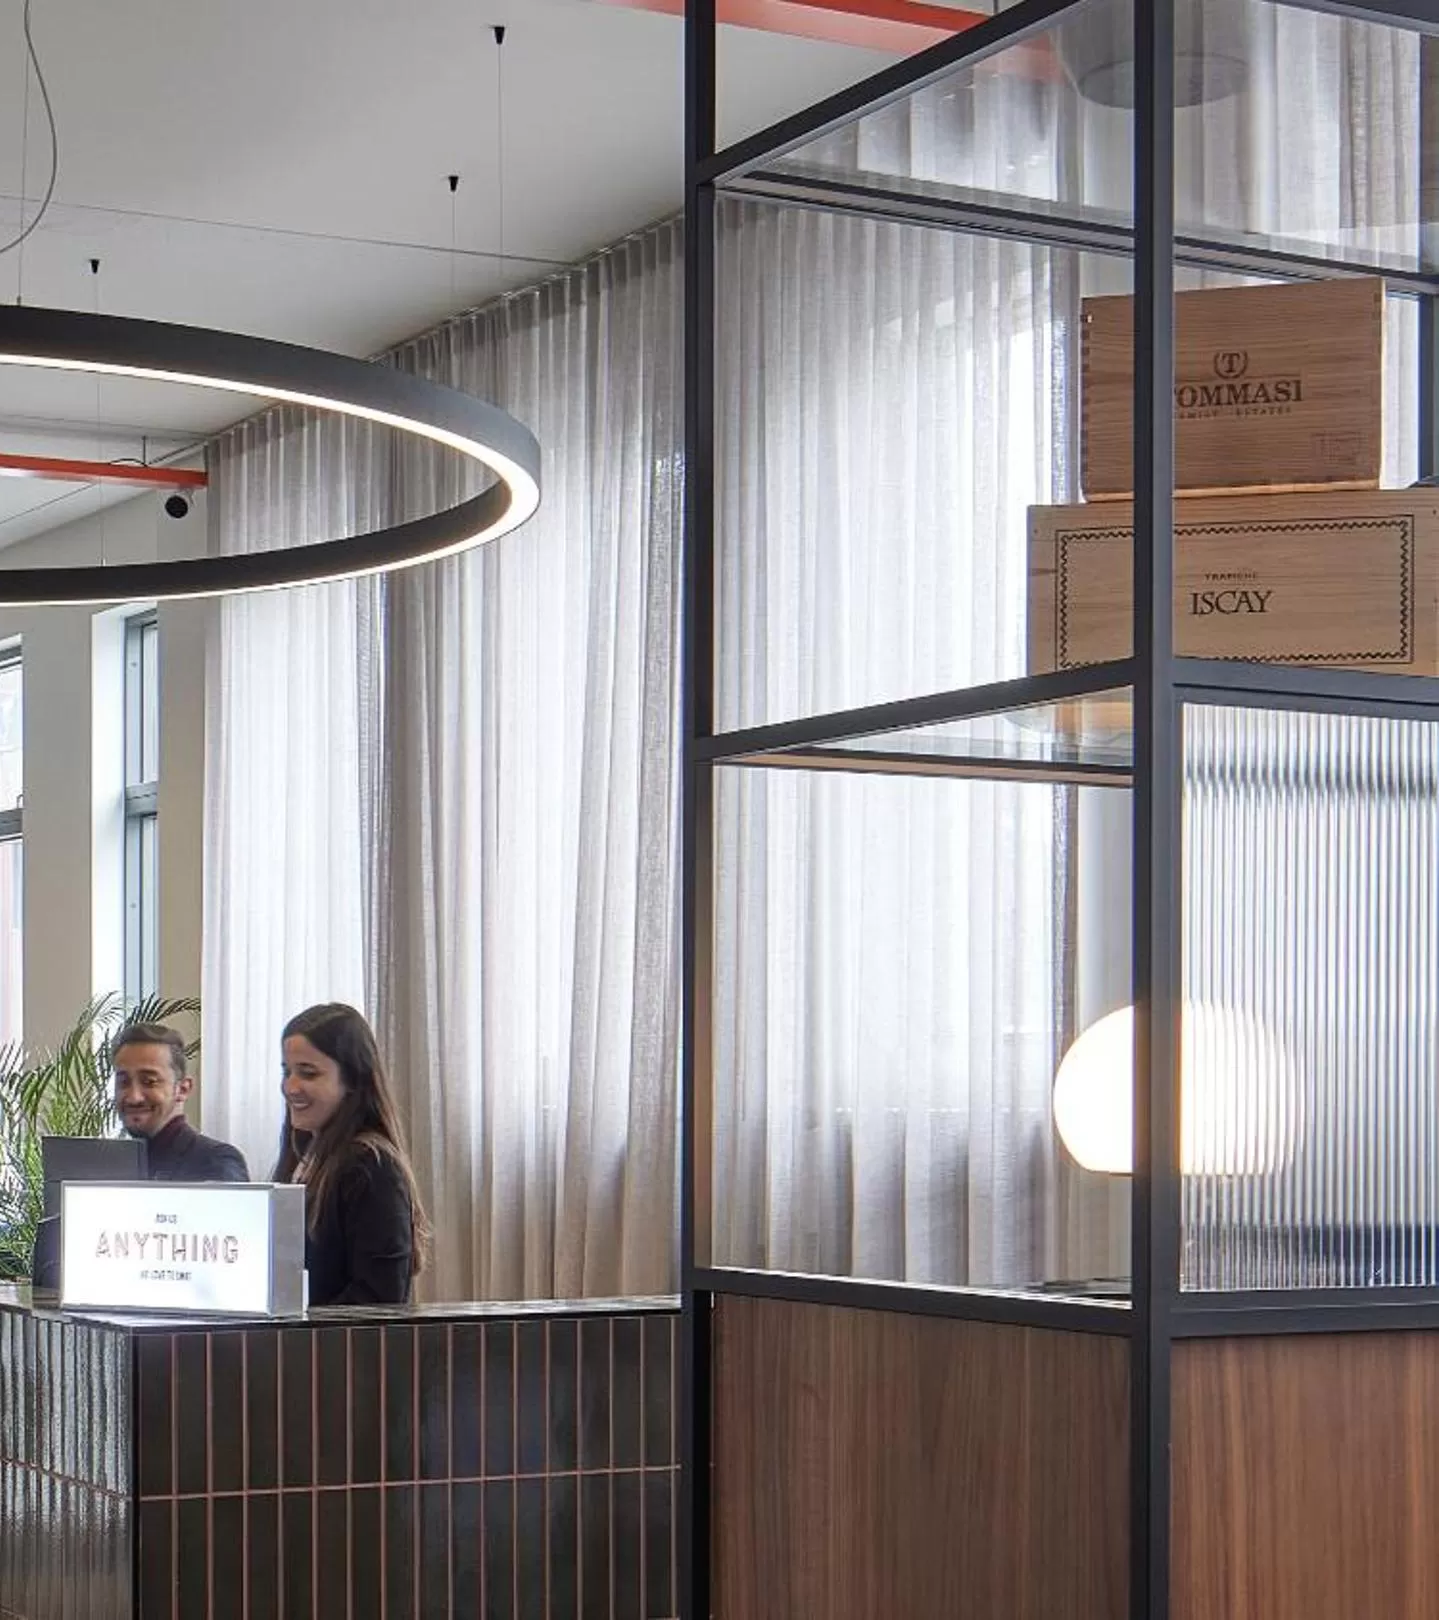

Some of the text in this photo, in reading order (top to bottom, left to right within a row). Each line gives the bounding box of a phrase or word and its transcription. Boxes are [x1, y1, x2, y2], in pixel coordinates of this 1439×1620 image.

[1174, 379, 1304, 408] OMMASI
[1188, 590, 1274, 616] ISCAY
[95, 1230, 239, 1264] ANYTHING
